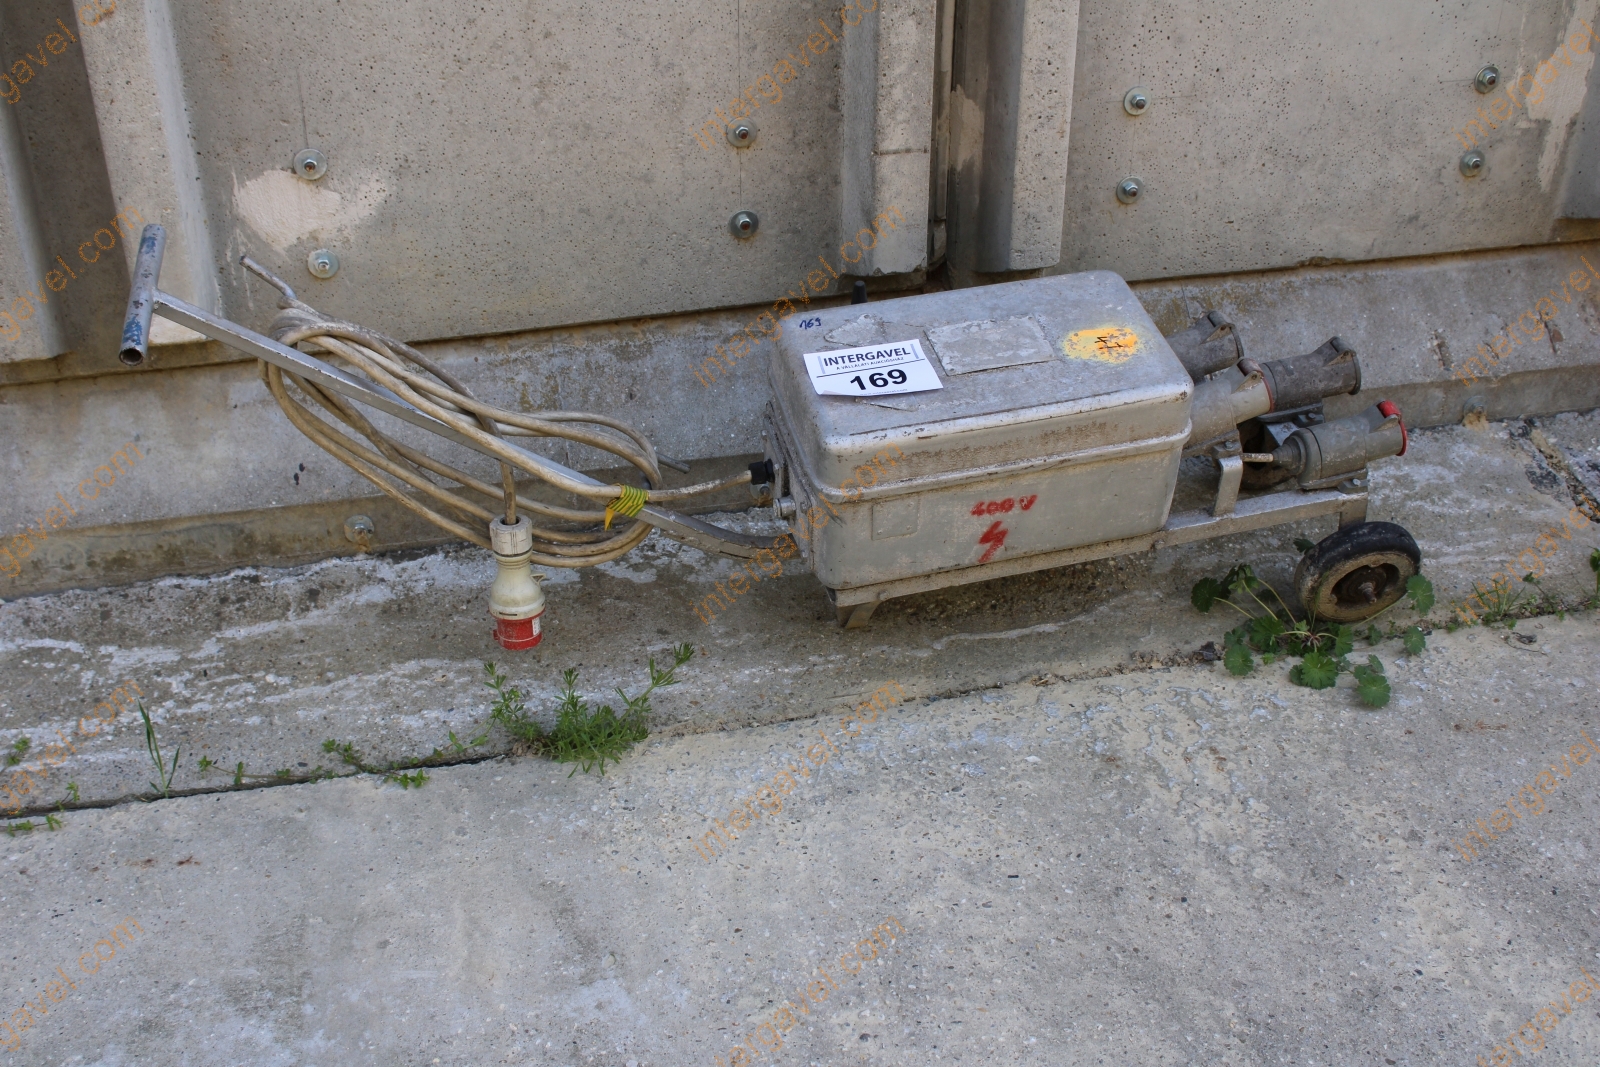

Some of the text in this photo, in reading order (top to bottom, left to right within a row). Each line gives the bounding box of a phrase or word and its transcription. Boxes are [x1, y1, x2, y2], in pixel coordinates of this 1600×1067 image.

[799, 317, 821, 330] 169
[823, 346, 911, 367] INTERGAVEL
[849, 368, 908, 391] 169
